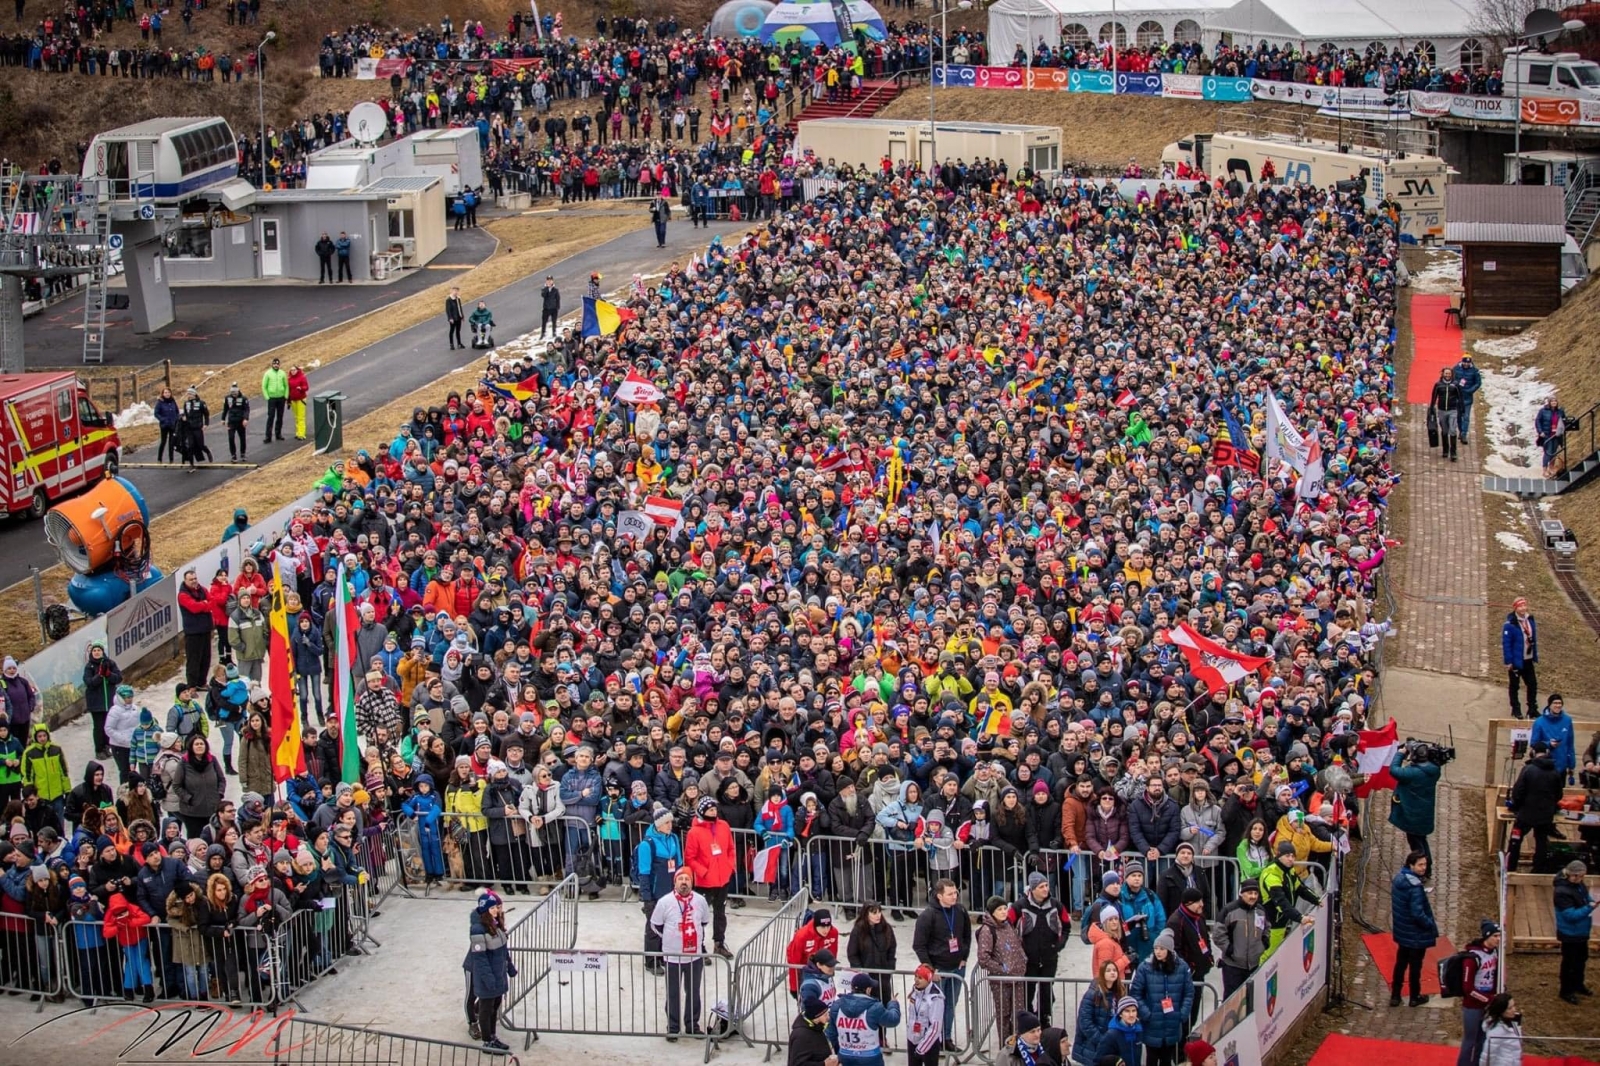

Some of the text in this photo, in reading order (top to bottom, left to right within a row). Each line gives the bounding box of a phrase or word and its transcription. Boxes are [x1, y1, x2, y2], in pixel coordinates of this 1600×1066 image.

[115, 605, 172, 657] BRACOMA
[837, 1017, 867, 1030] AVIA
[844, 1032, 861, 1044] 13
